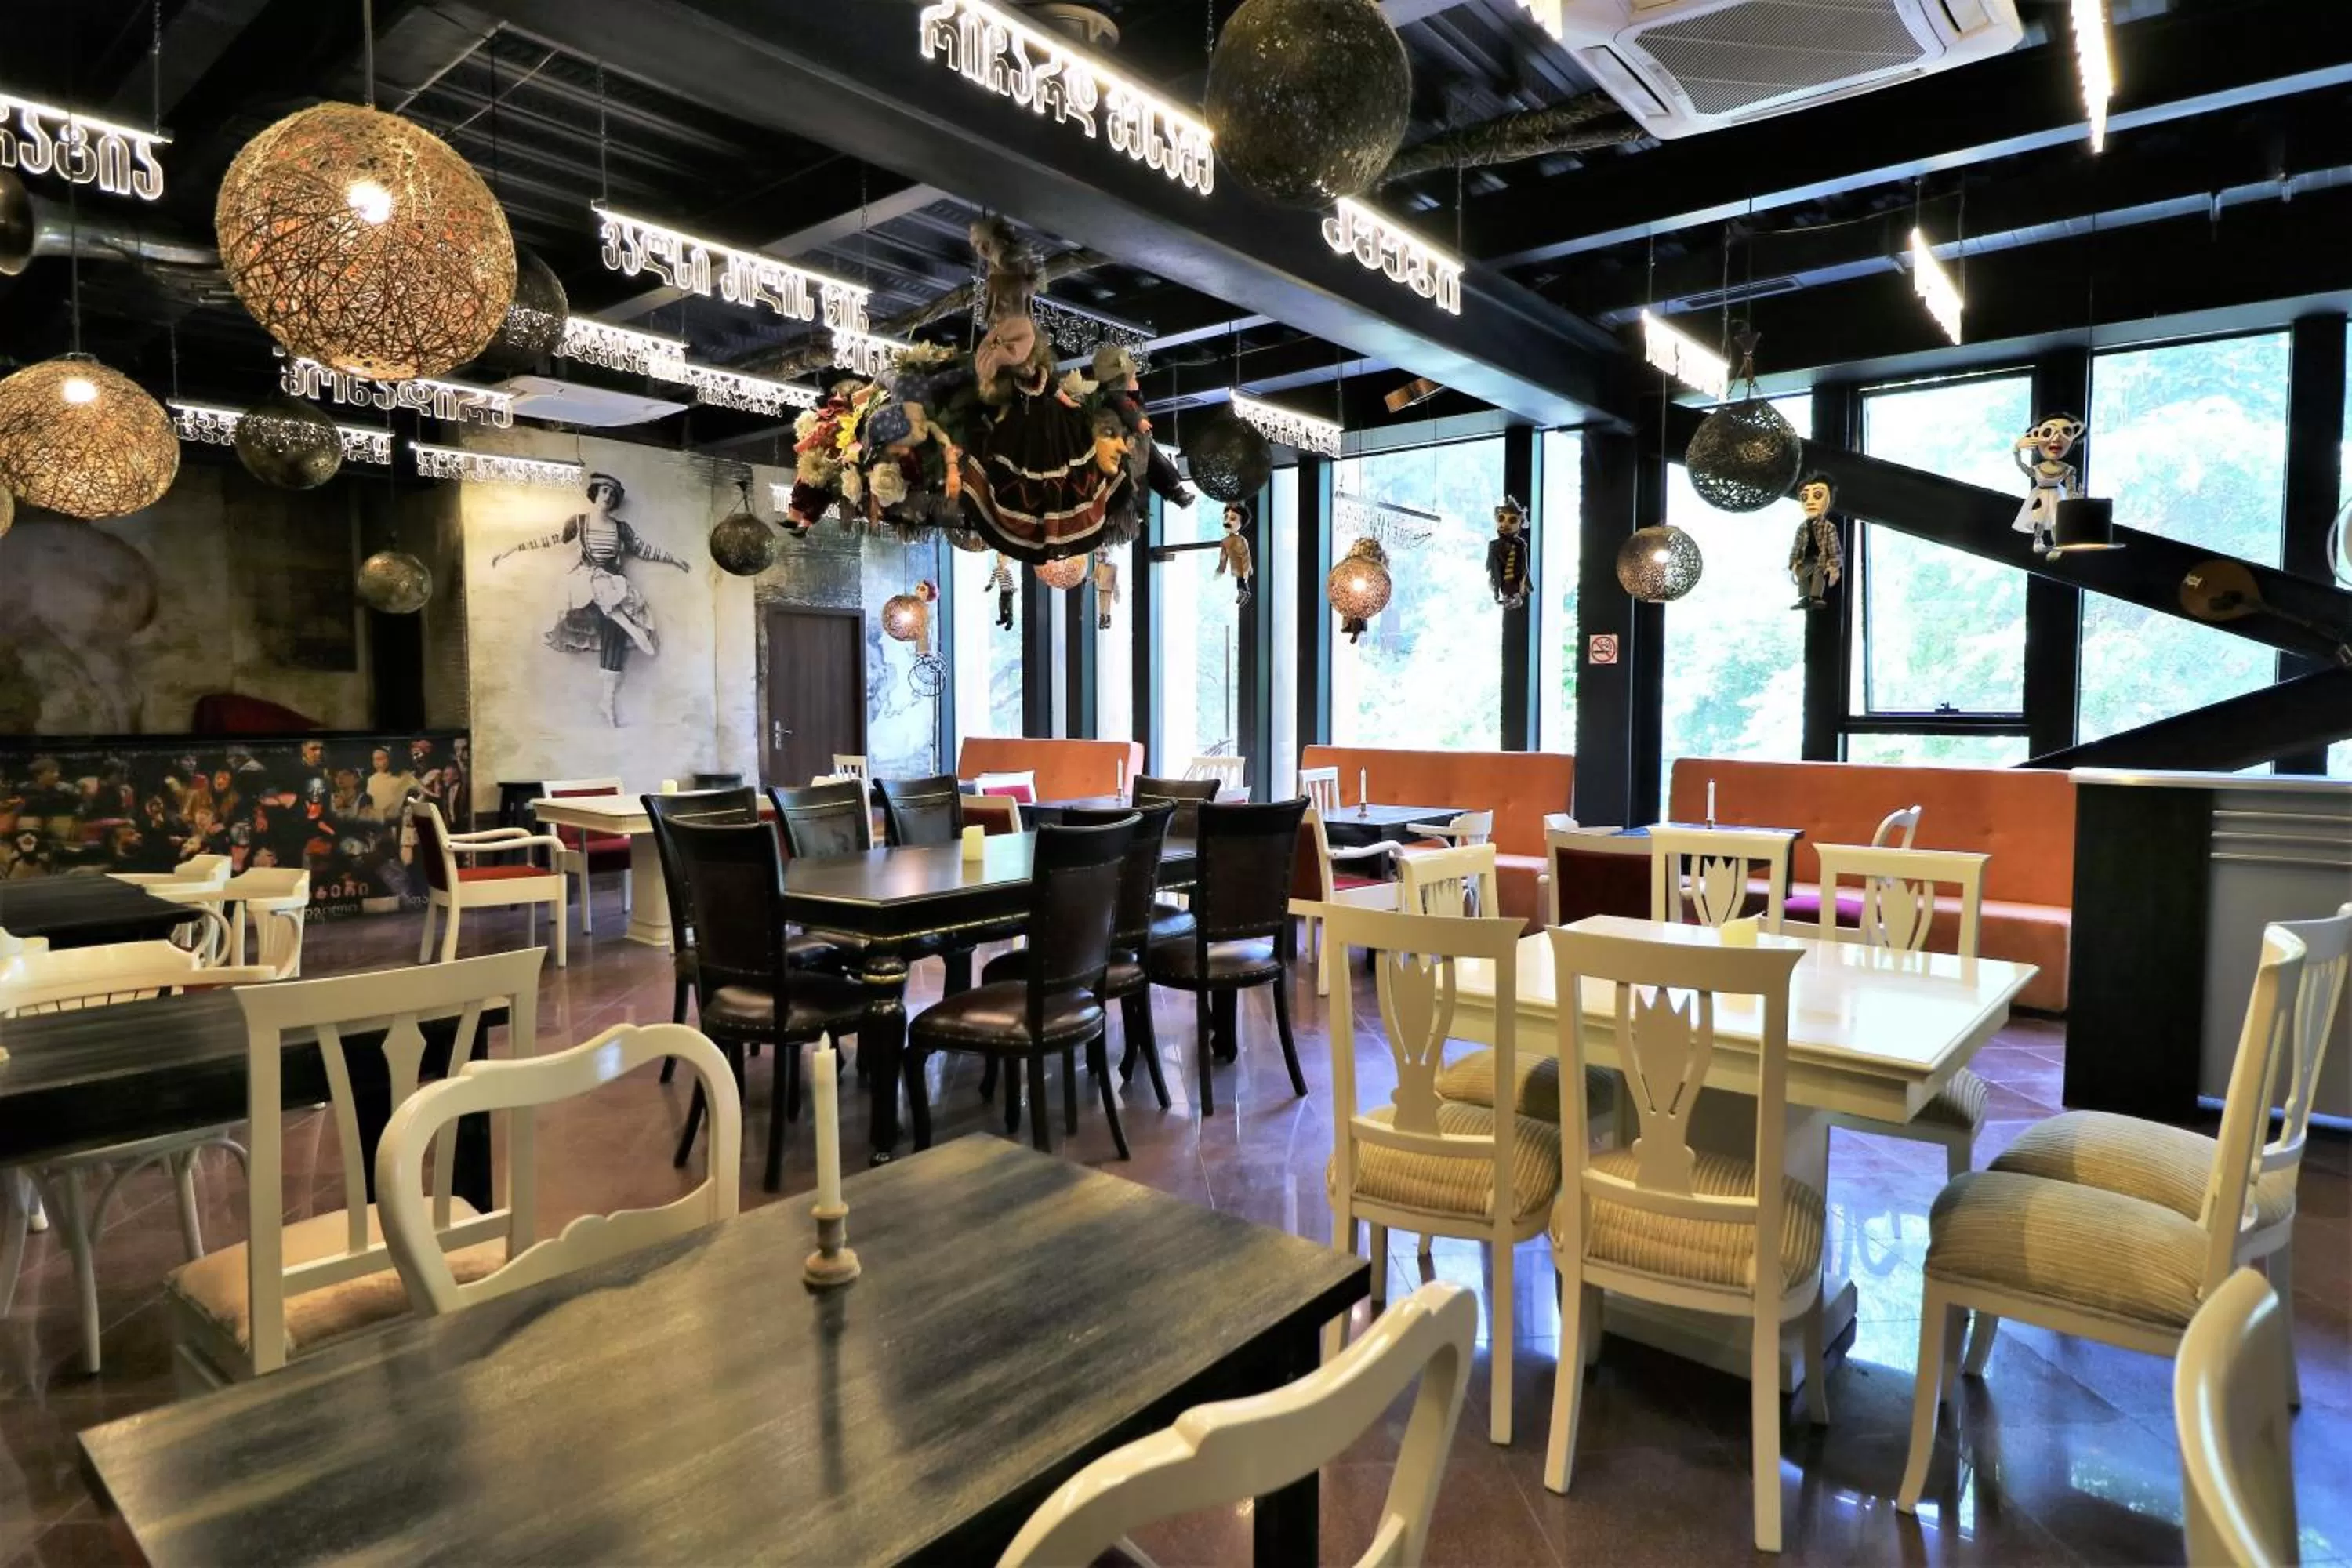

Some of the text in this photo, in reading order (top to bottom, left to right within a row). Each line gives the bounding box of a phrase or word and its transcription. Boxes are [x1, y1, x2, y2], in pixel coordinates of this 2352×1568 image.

[920, 0, 1214, 196] რიჩარდ მესამე
[601, 220, 711, 296] ვალსი
[720, 252, 815, 322] ძილის
[1321, 201, 1461, 316] ძმები
[280, 363, 514, 430] მონადირე
